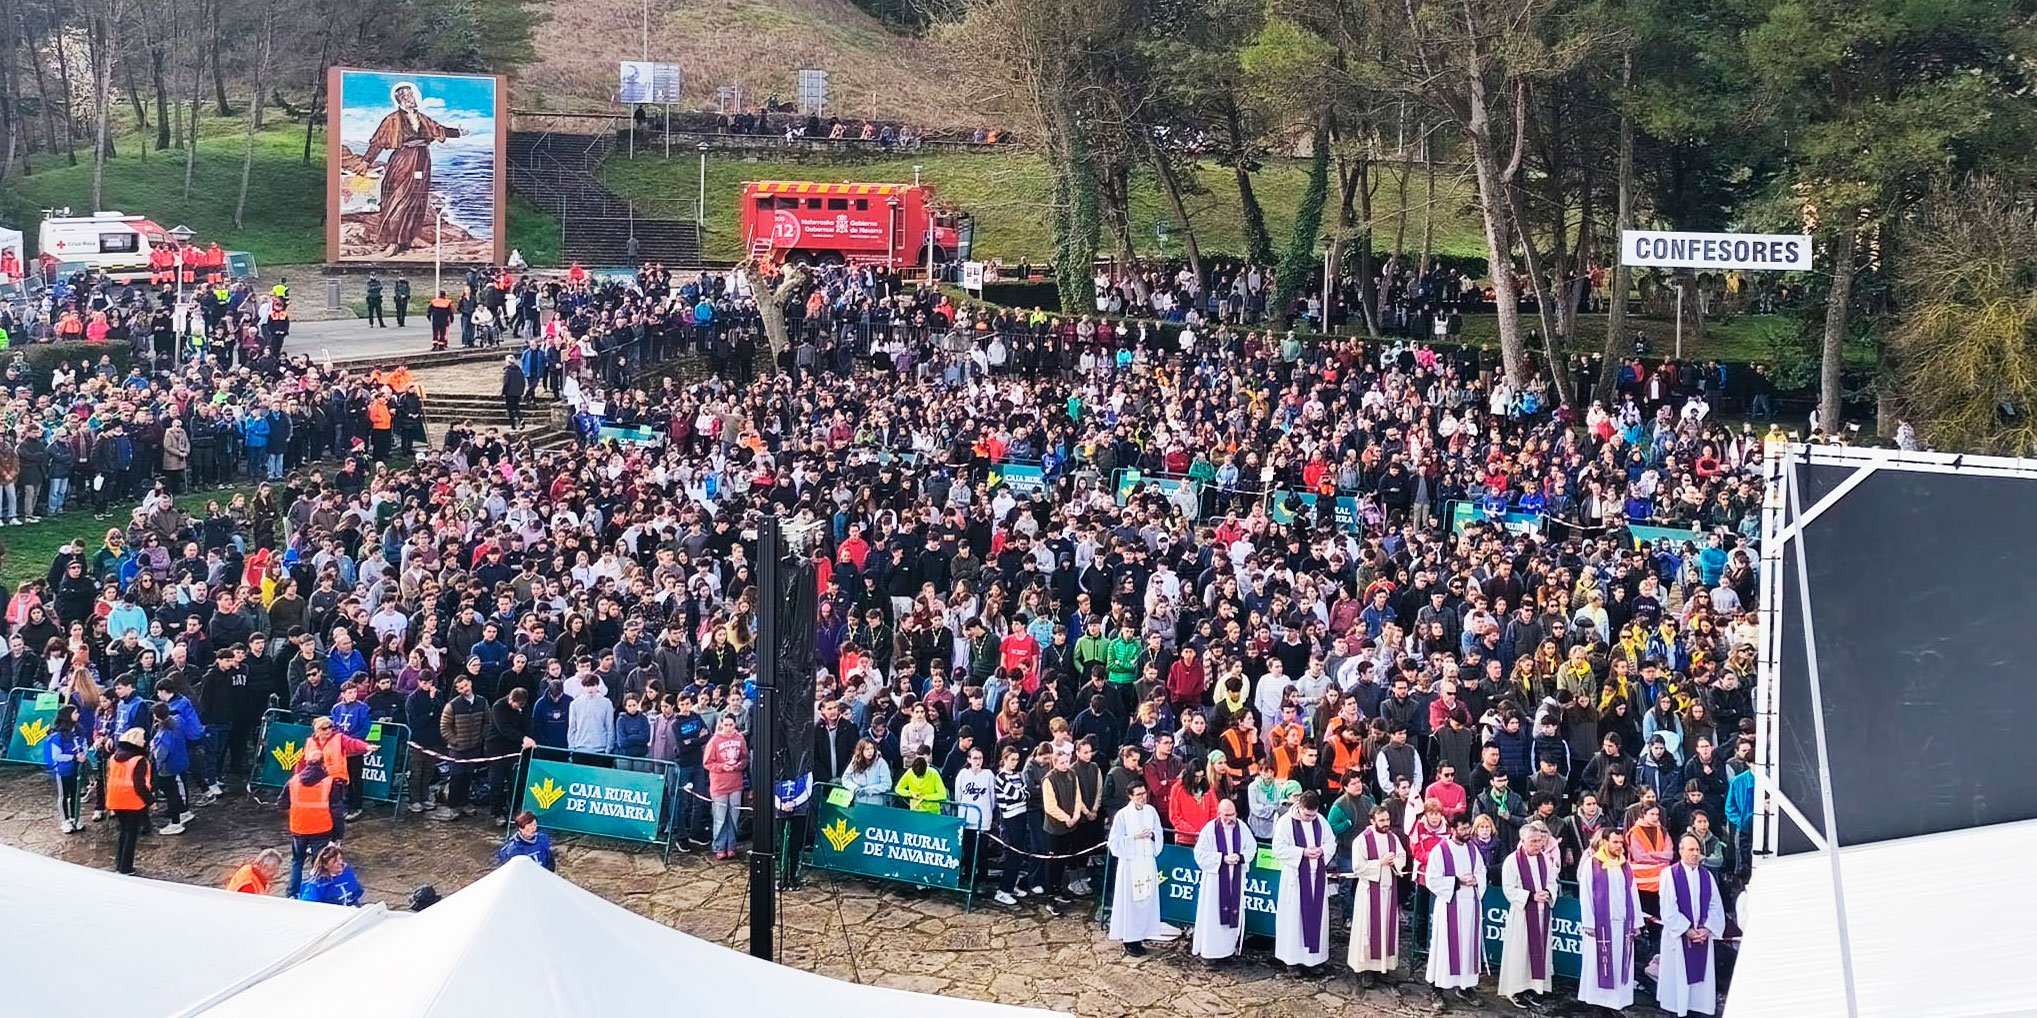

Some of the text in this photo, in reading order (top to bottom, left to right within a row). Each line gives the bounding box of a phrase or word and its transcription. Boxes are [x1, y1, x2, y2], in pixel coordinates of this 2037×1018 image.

[1636, 237, 1799, 263] CONFESORES
[569, 782, 651, 806] CAJA RURAL
[566, 798, 656, 822] DE NAVARRA
[865, 827, 951, 852] CAJA RURAL
[863, 842, 957, 869] DE NAVARRA
[1171, 867, 1202, 884] CAJ
[1169, 884, 1194, 901] DE
